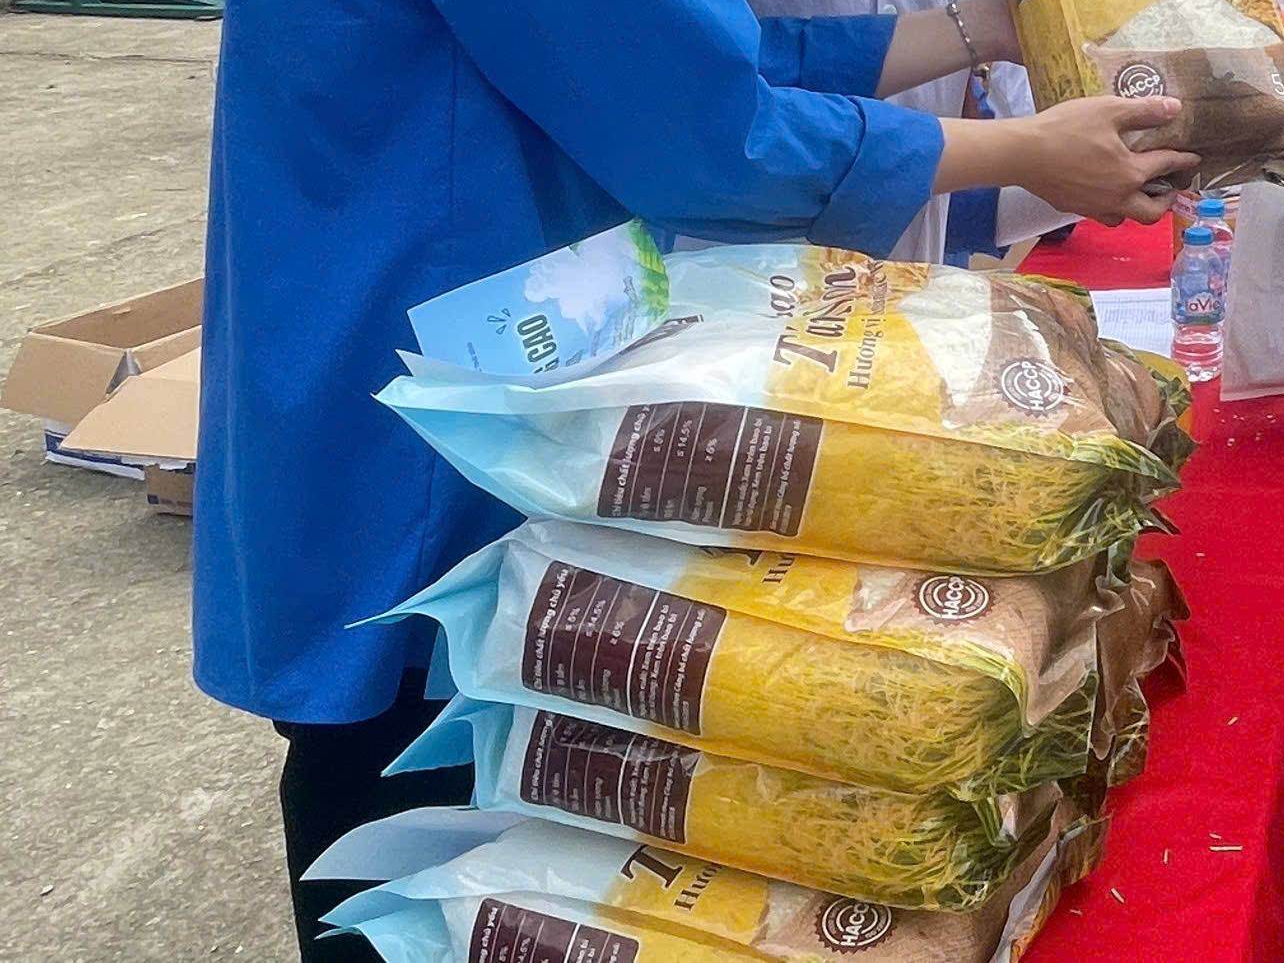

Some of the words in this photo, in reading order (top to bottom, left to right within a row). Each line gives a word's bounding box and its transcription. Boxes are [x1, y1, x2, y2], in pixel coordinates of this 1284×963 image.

[1121, 74, 1160, 97] HACCP
[517, 314, 557, 362] CAO
[847, 330, 883, 389] Hương
[1021, 360, 1046, 410] HACCP
[547, 588, 562, 608] chủ
[840, 903, 869, 946] HACC
